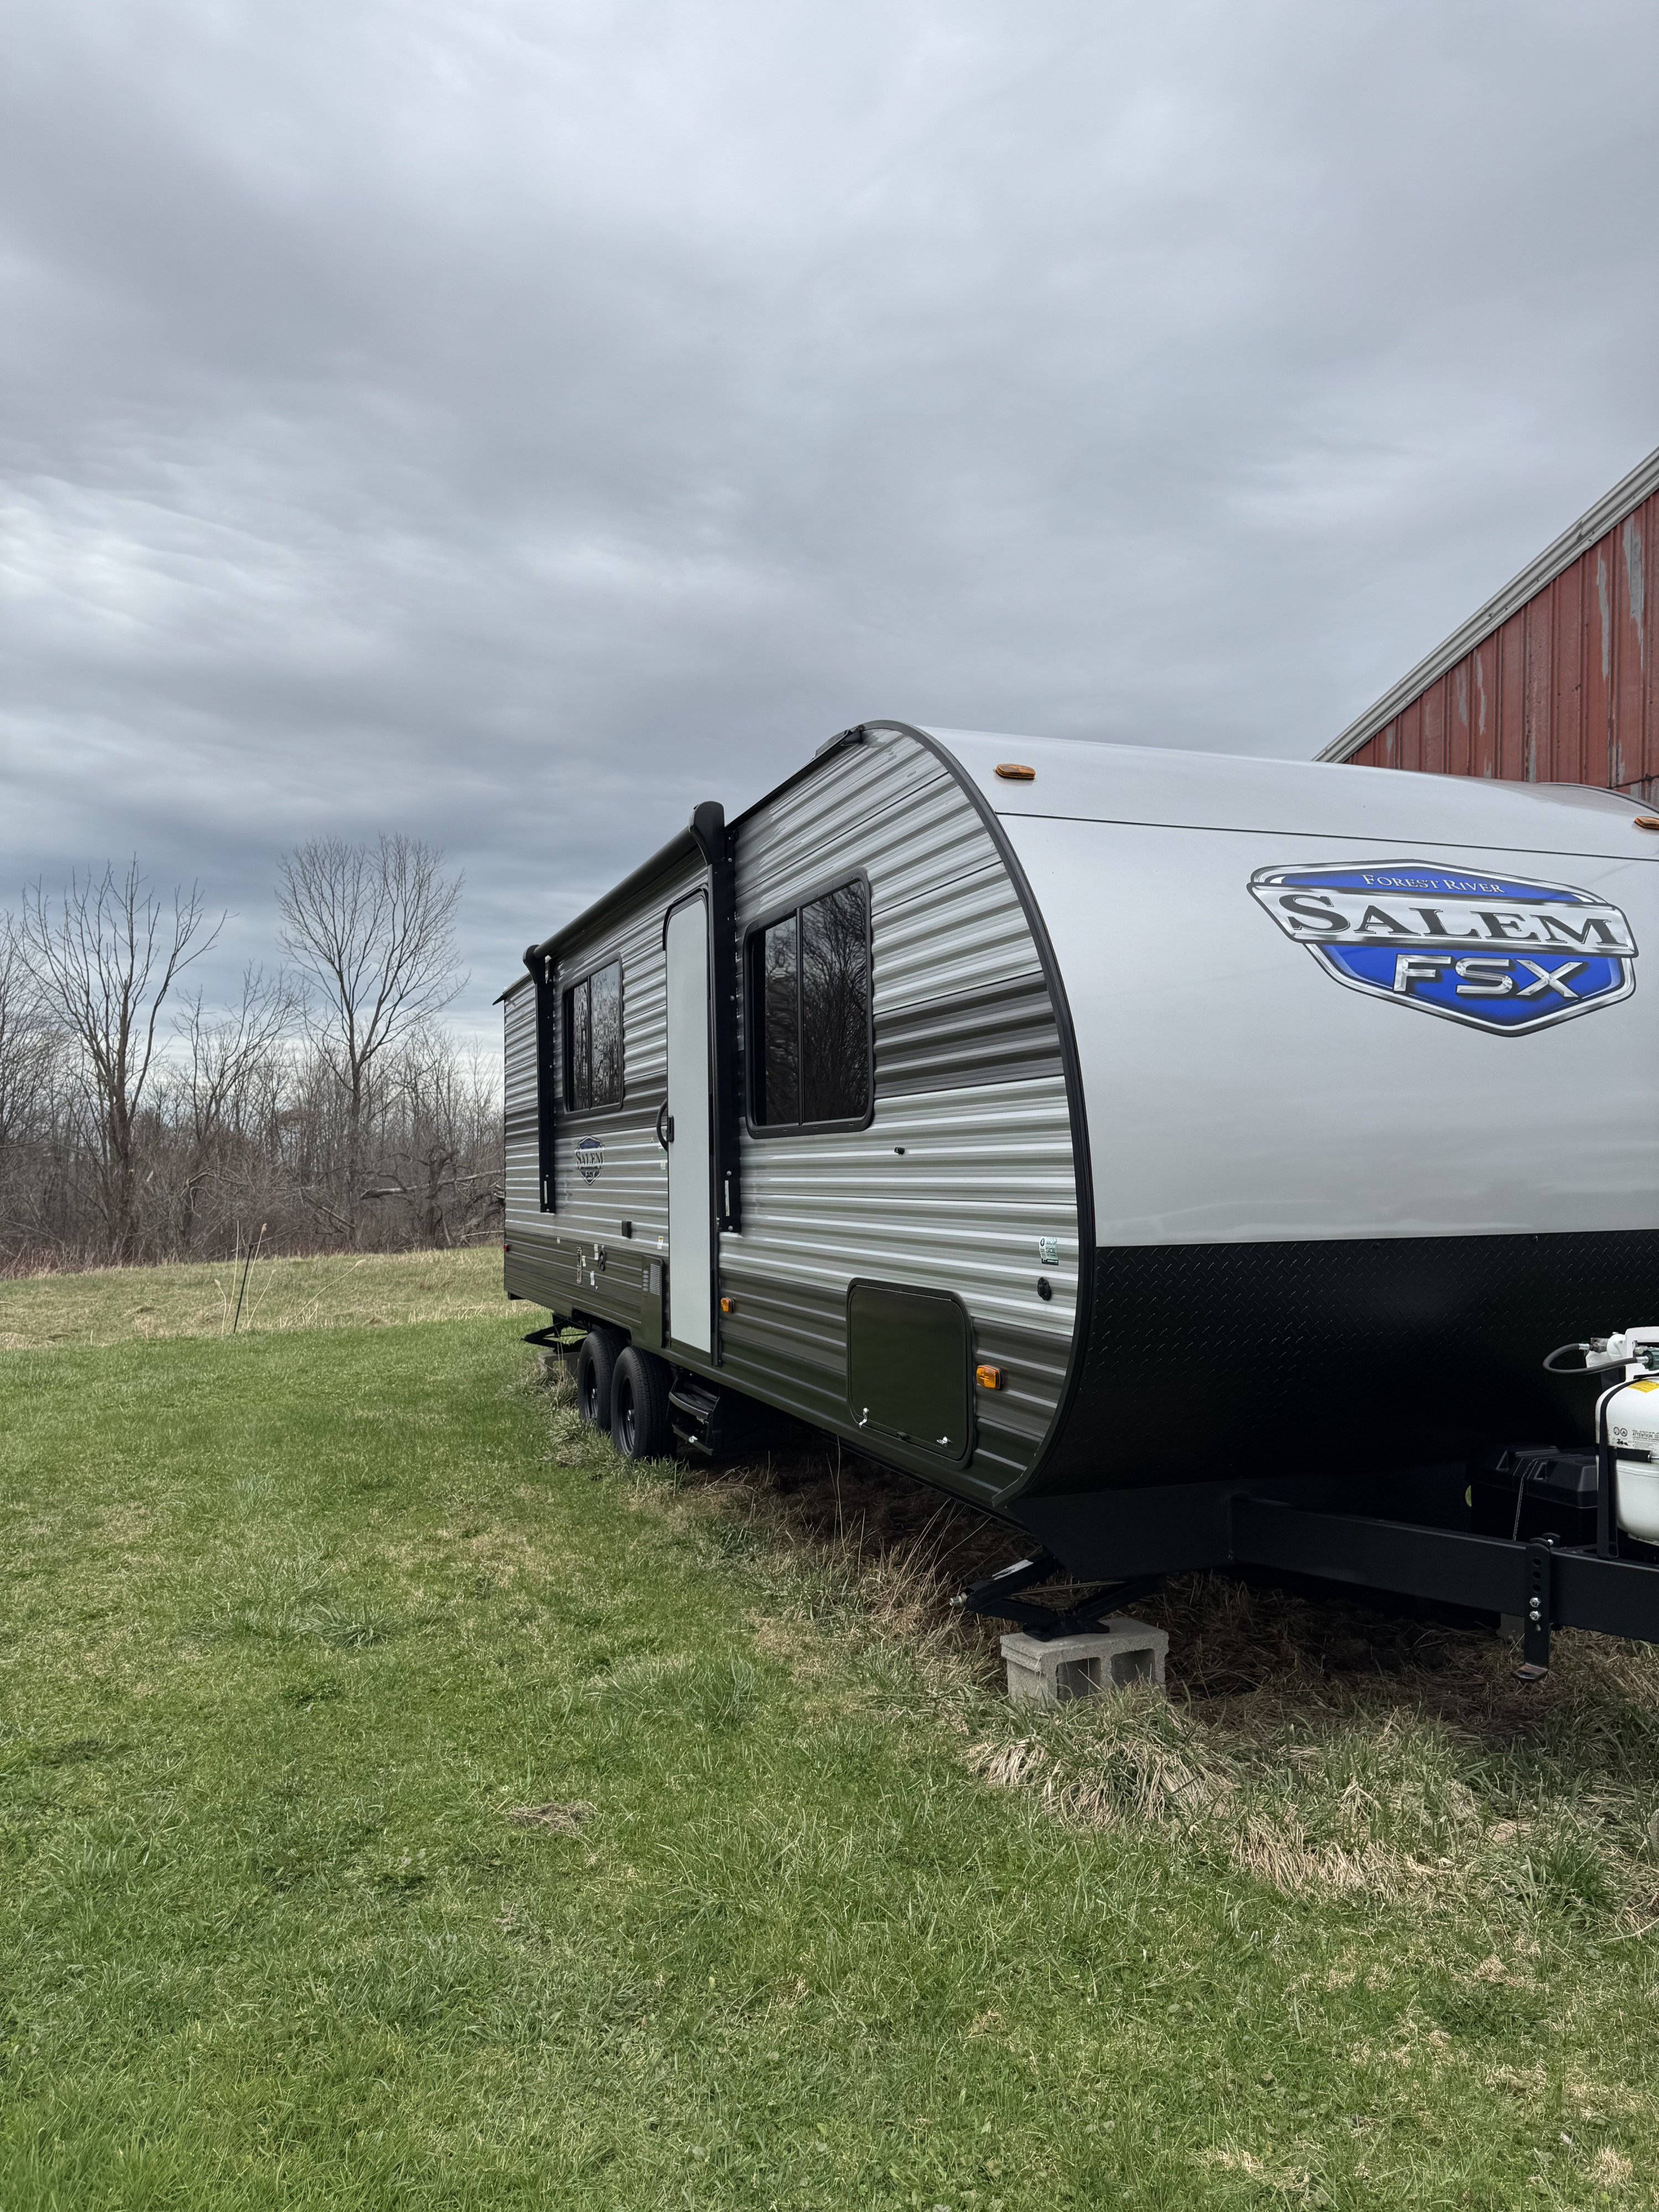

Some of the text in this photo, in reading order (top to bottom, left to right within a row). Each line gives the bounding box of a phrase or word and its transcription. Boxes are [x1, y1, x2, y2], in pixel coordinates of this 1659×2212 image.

[1361, 874, 1505, 893] FOREST RIVER
[1278, 894, 1629, 947] SALEM
[1394, 954, 1583, 998] FSX
[576, 1151, 603, 1165] SALEM
